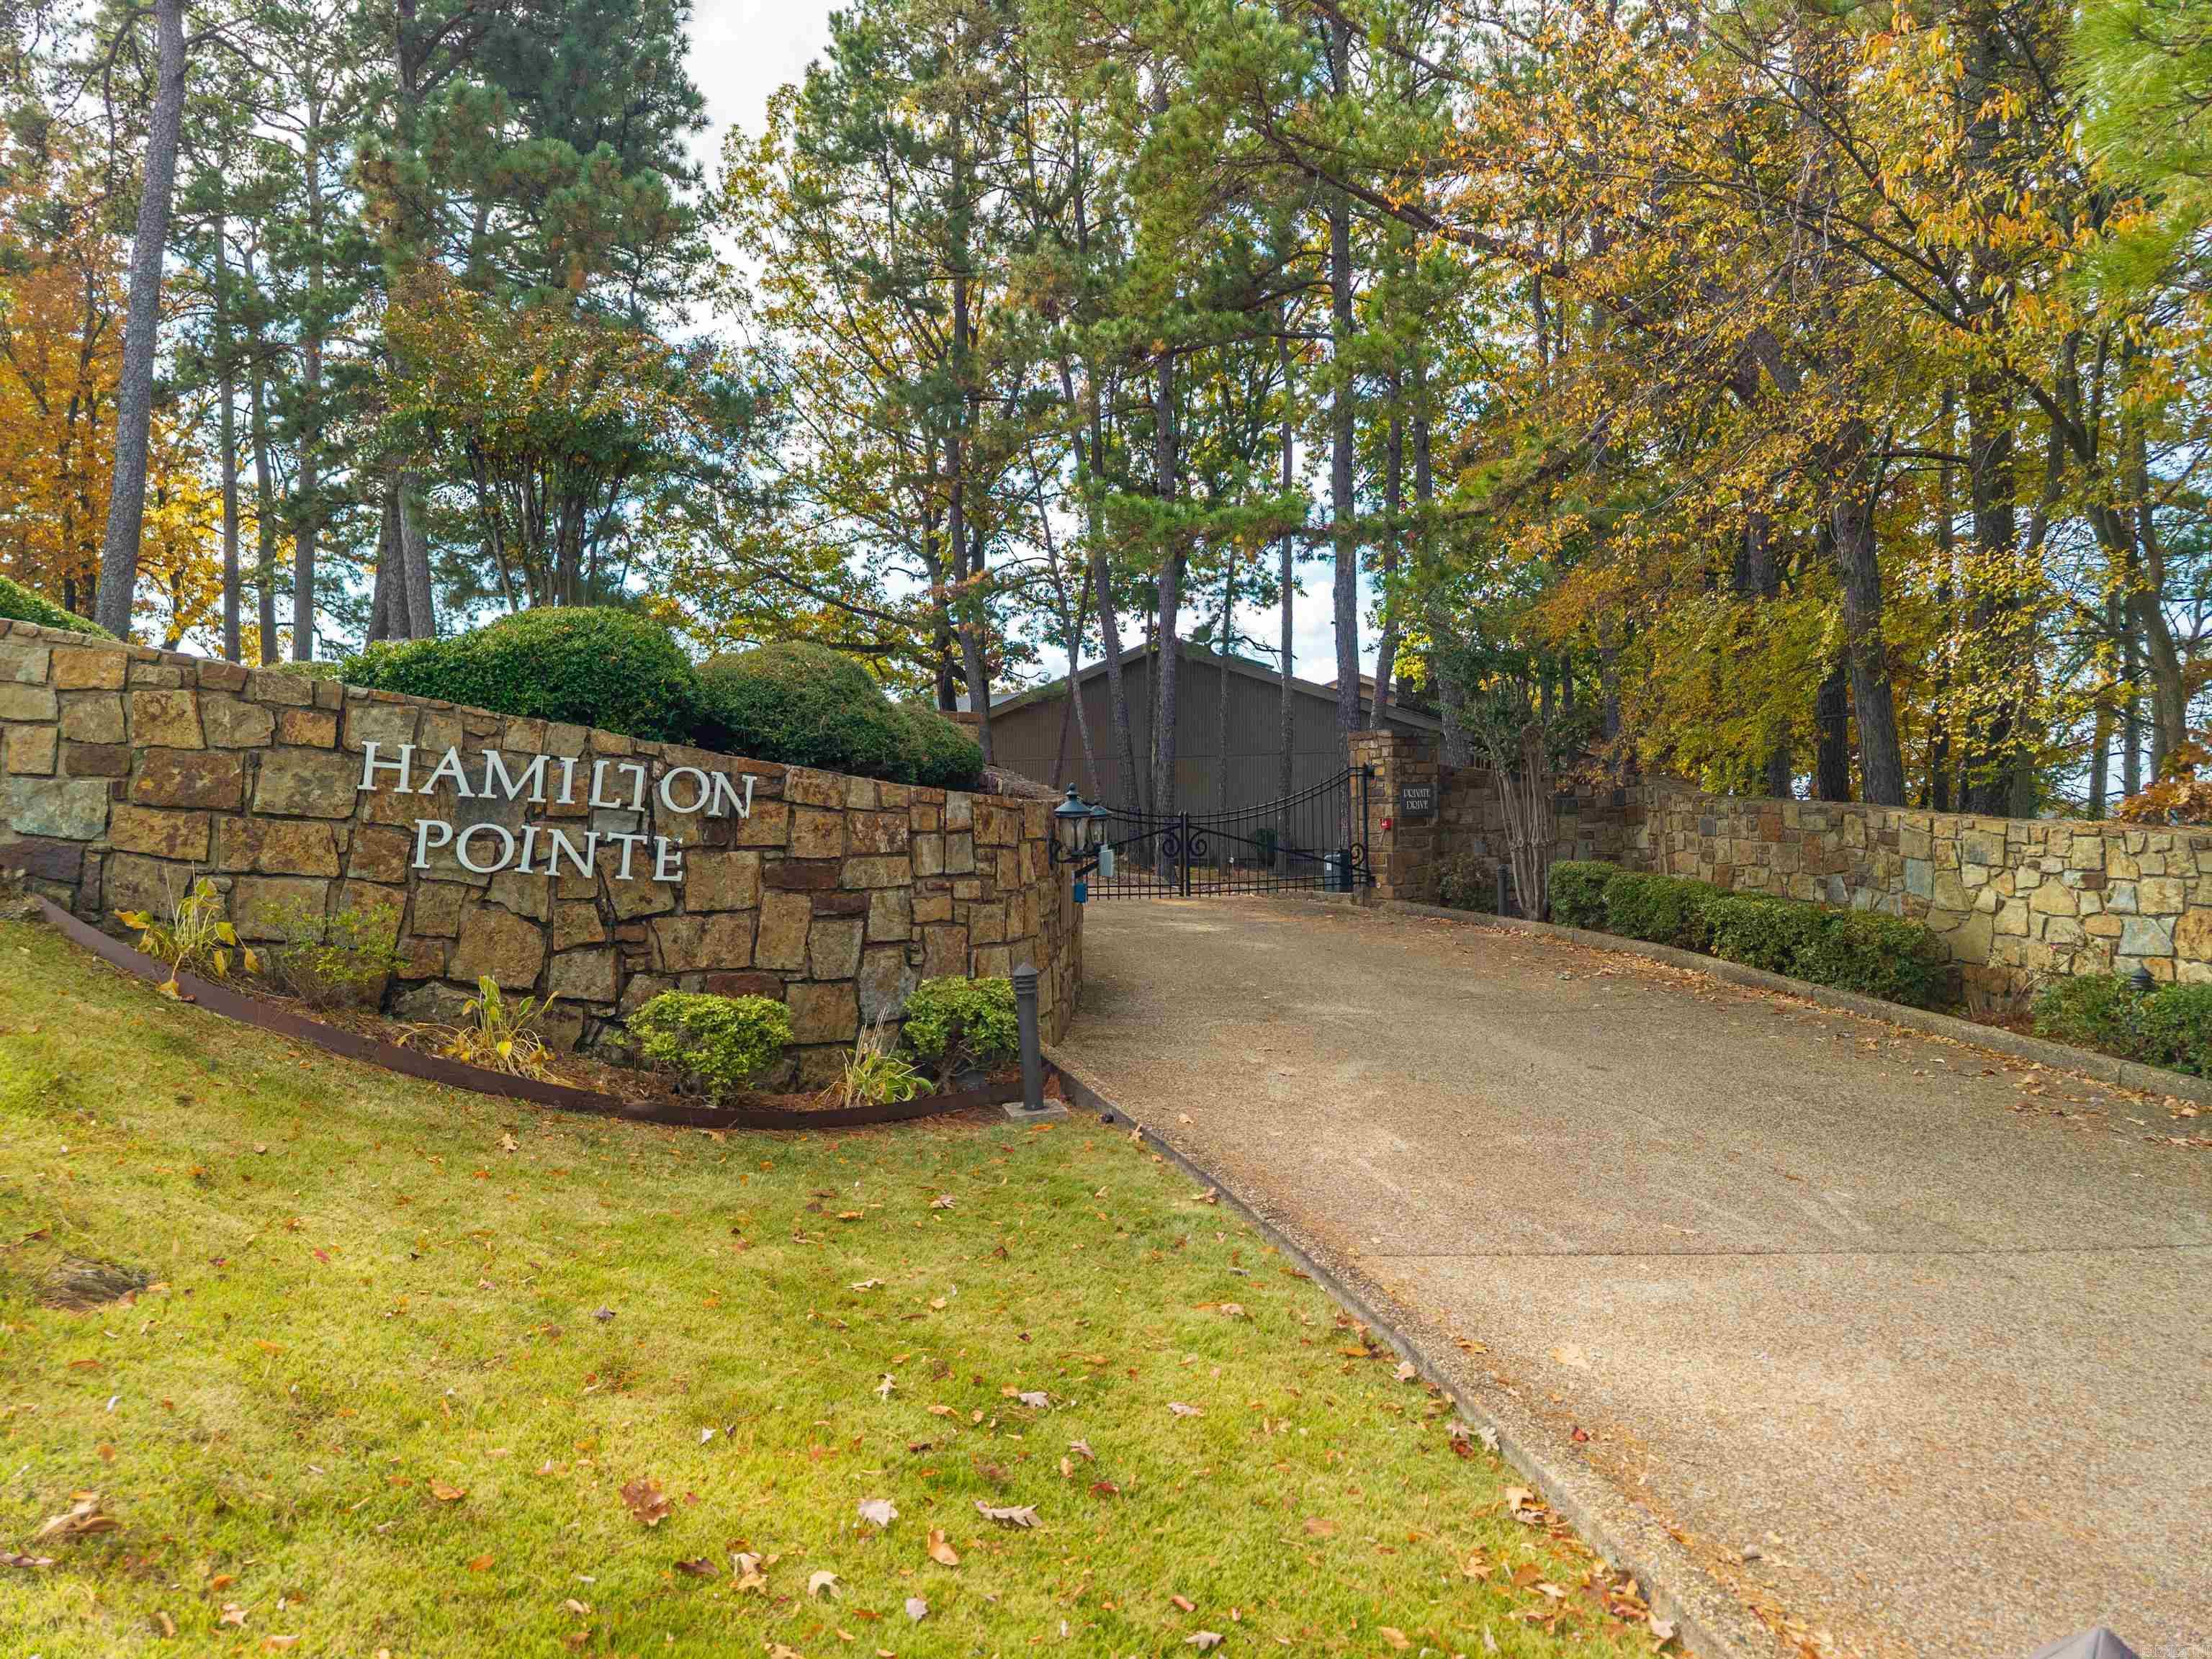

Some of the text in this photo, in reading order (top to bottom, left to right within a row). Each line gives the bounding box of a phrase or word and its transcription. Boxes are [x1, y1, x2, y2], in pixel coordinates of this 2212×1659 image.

[357, 740, 757, 819] HAMILTON
[1403, 788, 1430, 798] PRIVATE
[1406, 800, 1429, 810] DRIVE
[411, 818, 684, 882] POINTE
